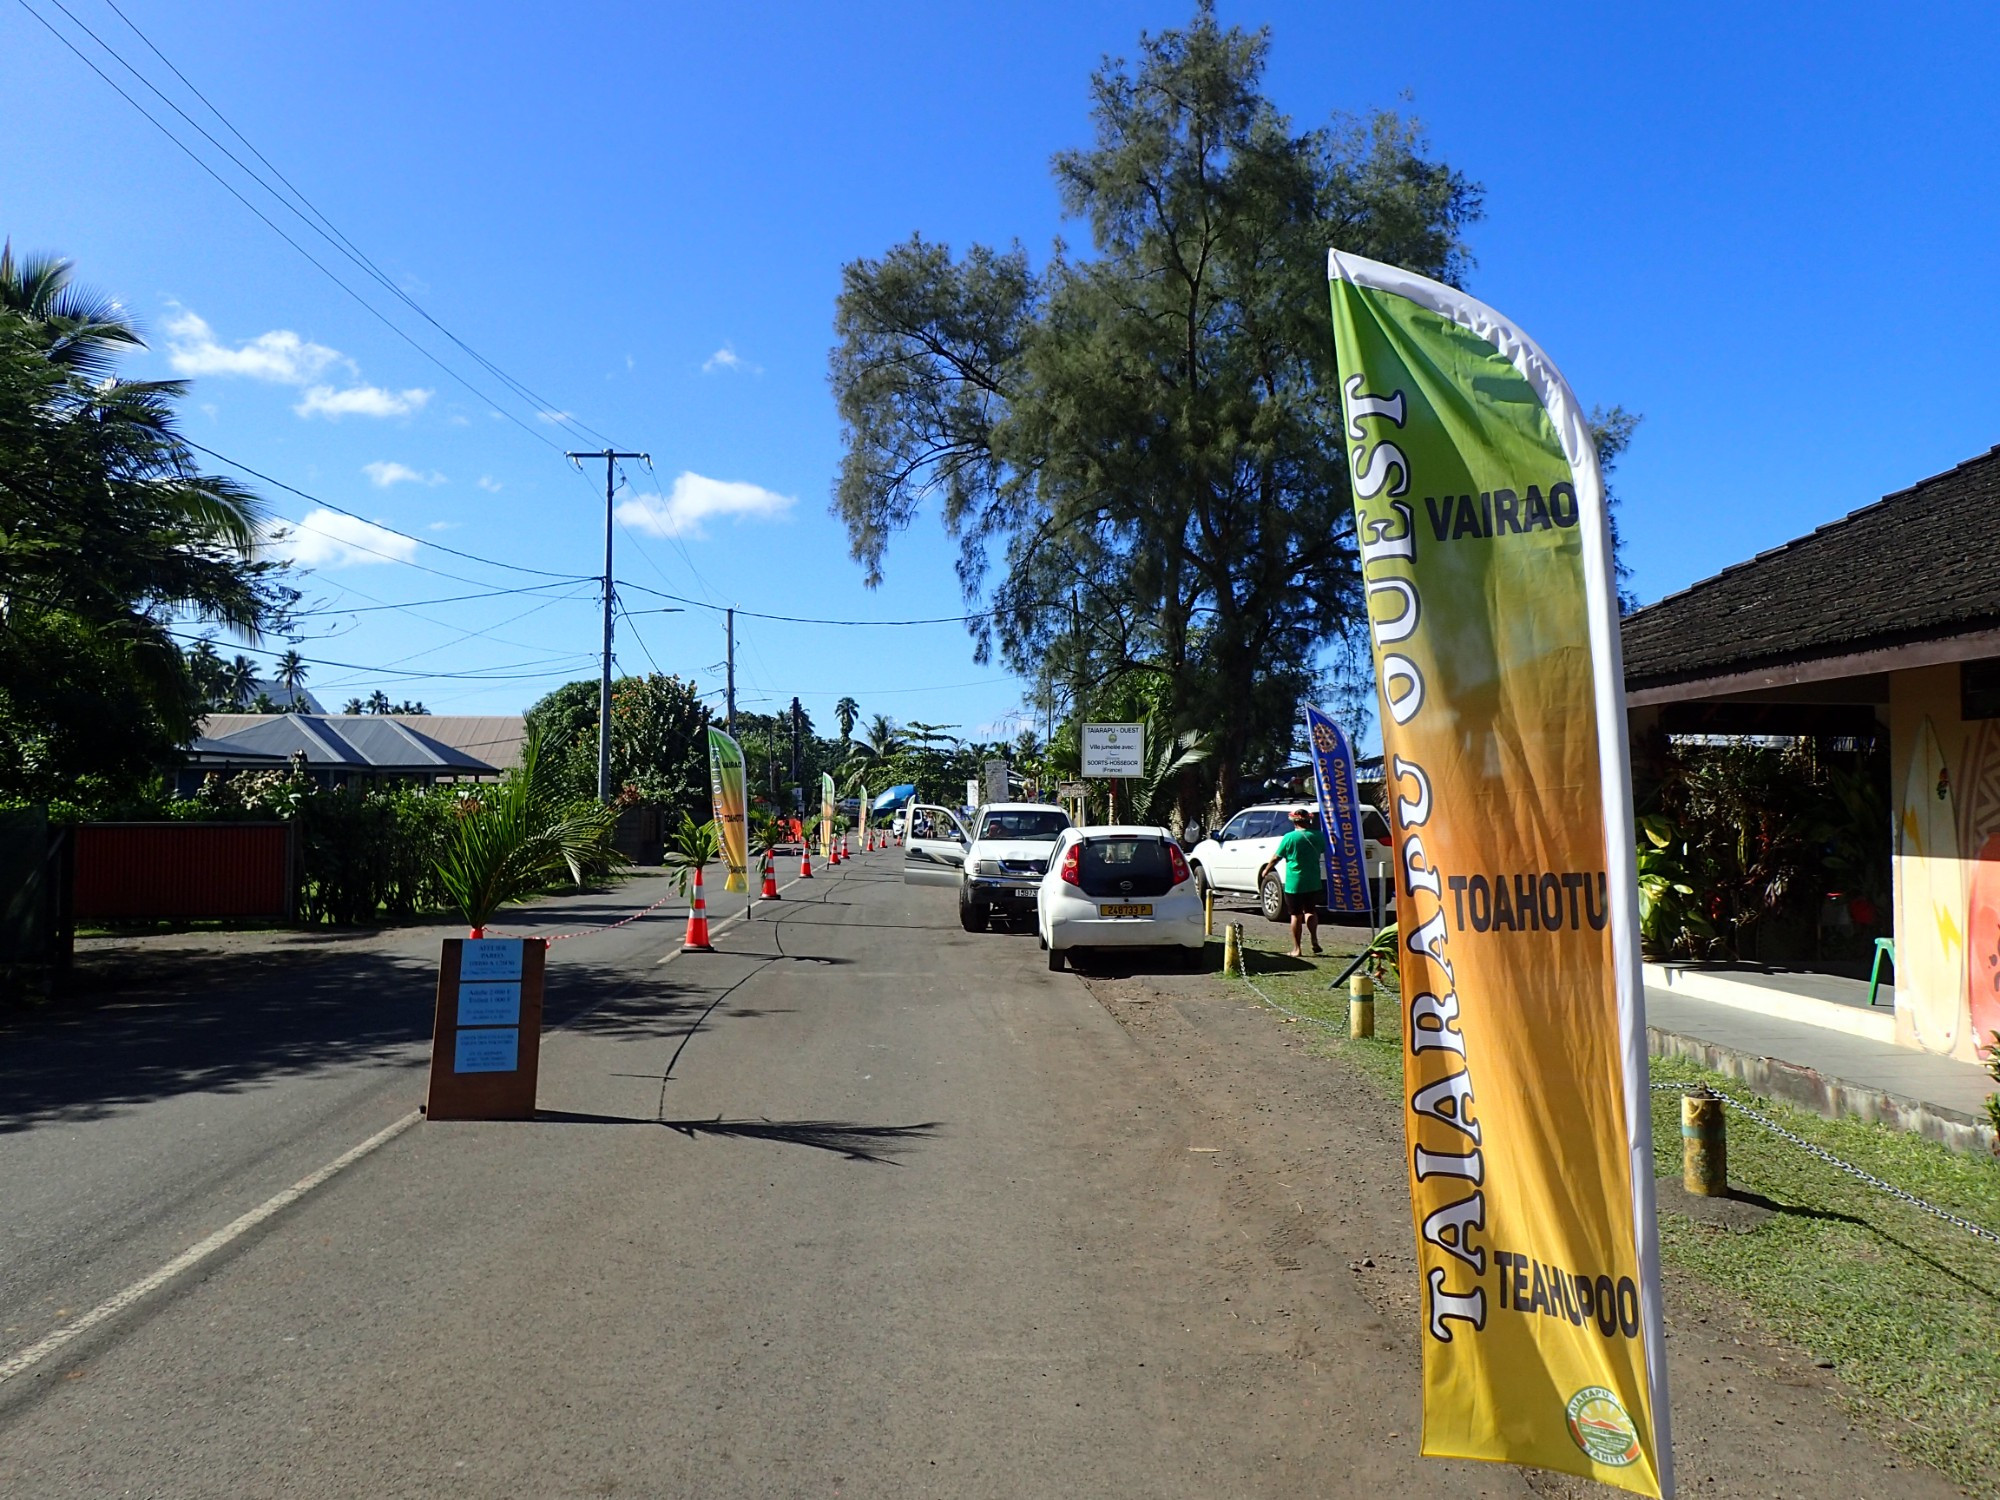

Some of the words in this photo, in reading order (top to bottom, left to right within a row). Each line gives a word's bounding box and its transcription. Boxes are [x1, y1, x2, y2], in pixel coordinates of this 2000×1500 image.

[1424, 481, 1579, 542] VAIRAO
[1344, 373, 1426, 726] OUEST
[1141, 905, 1146, 914] P
[1448, 871, 1611, 933] TOAHOTU
[1394, 752, 1486, 1344] TAIARAPU
[1493, 1251, 1640, 1339] TEAHUPOO
[1568, 1389, 1609, 1418] TAIARAPU
[1585, 1445, 1627, 1463] TAHITI
